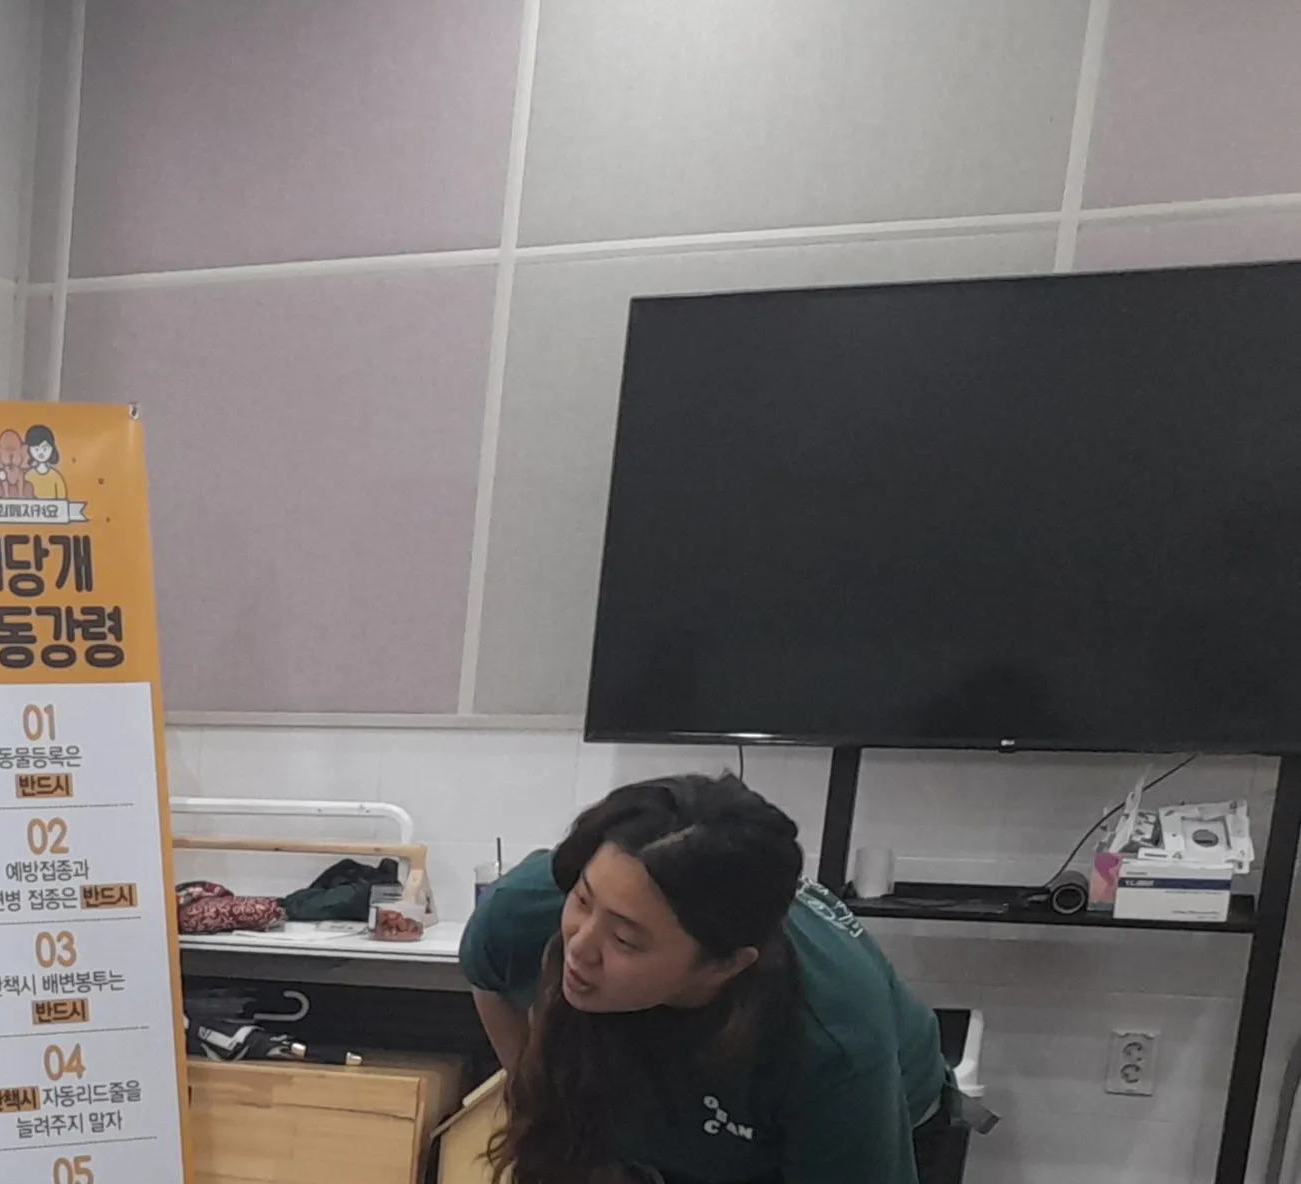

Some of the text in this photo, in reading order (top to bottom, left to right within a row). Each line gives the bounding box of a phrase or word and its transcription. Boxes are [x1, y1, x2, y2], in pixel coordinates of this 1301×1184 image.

[22, 704, 56, 741] 01
[18, 775, 71, 797] 반드시
[27, 817, 70, 855] 02
[6, 859, 90, 883] 예방접종과
[27, 888, 78, 910] 접종은
[82, 884, 135, 908] 반드시
[35, 930, 78, 968] 03
[42, 970, 126, 995] 배변봉투는
[35, 1000, 87, 1022] 반드시
[44, 1043, 86, 1081] 04
[42, 1080, 142, 1107] 자동리드줄을
[16, 1110, 122, 1139] 늘려주지 말자
